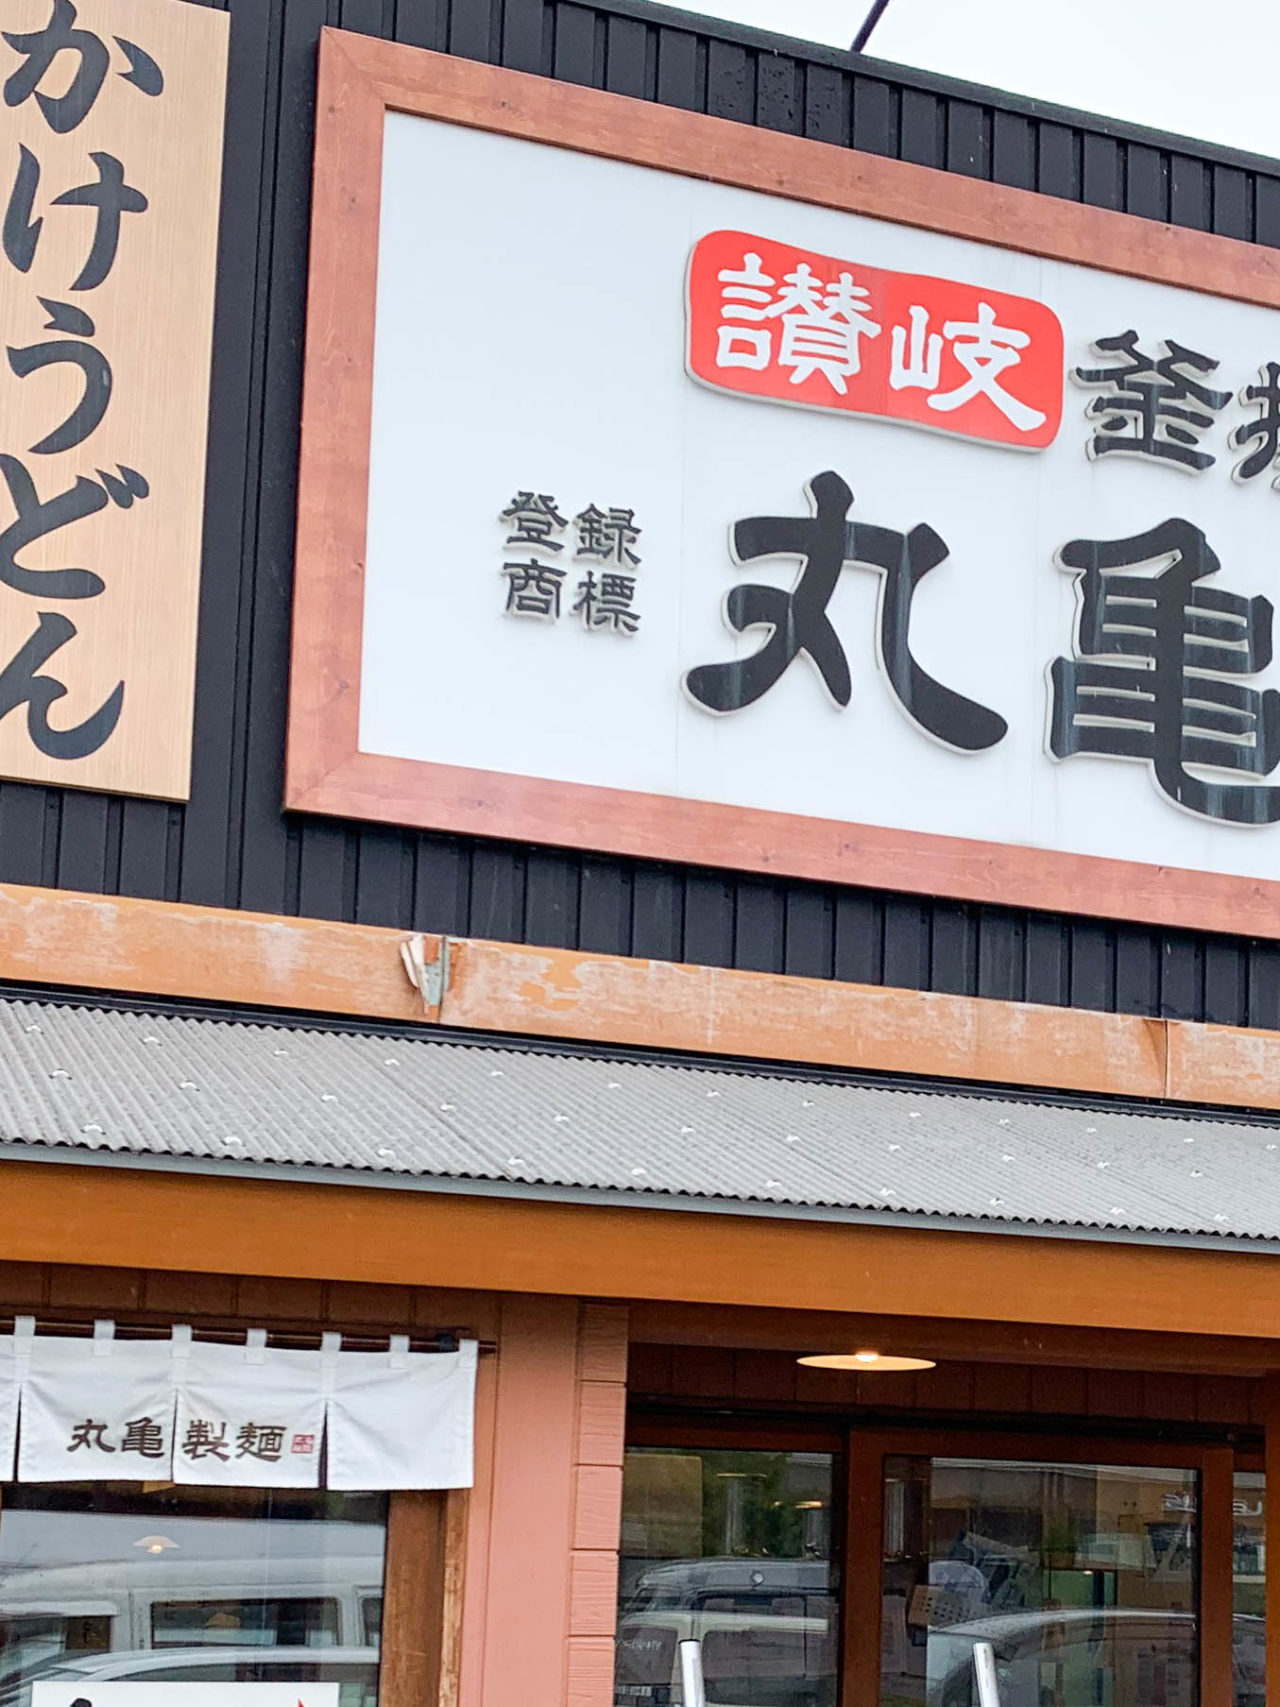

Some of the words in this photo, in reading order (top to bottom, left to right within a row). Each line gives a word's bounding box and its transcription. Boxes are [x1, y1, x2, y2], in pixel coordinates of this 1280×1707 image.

[0, 0, 165, 761] かけうどん
[717, 253, 1048, 431] 讃岐
[501, 490, 642, 567] 登録
[502, 557, 642, 634] 商標
[67, 1416, 287, 1462] 丸亀製麺
